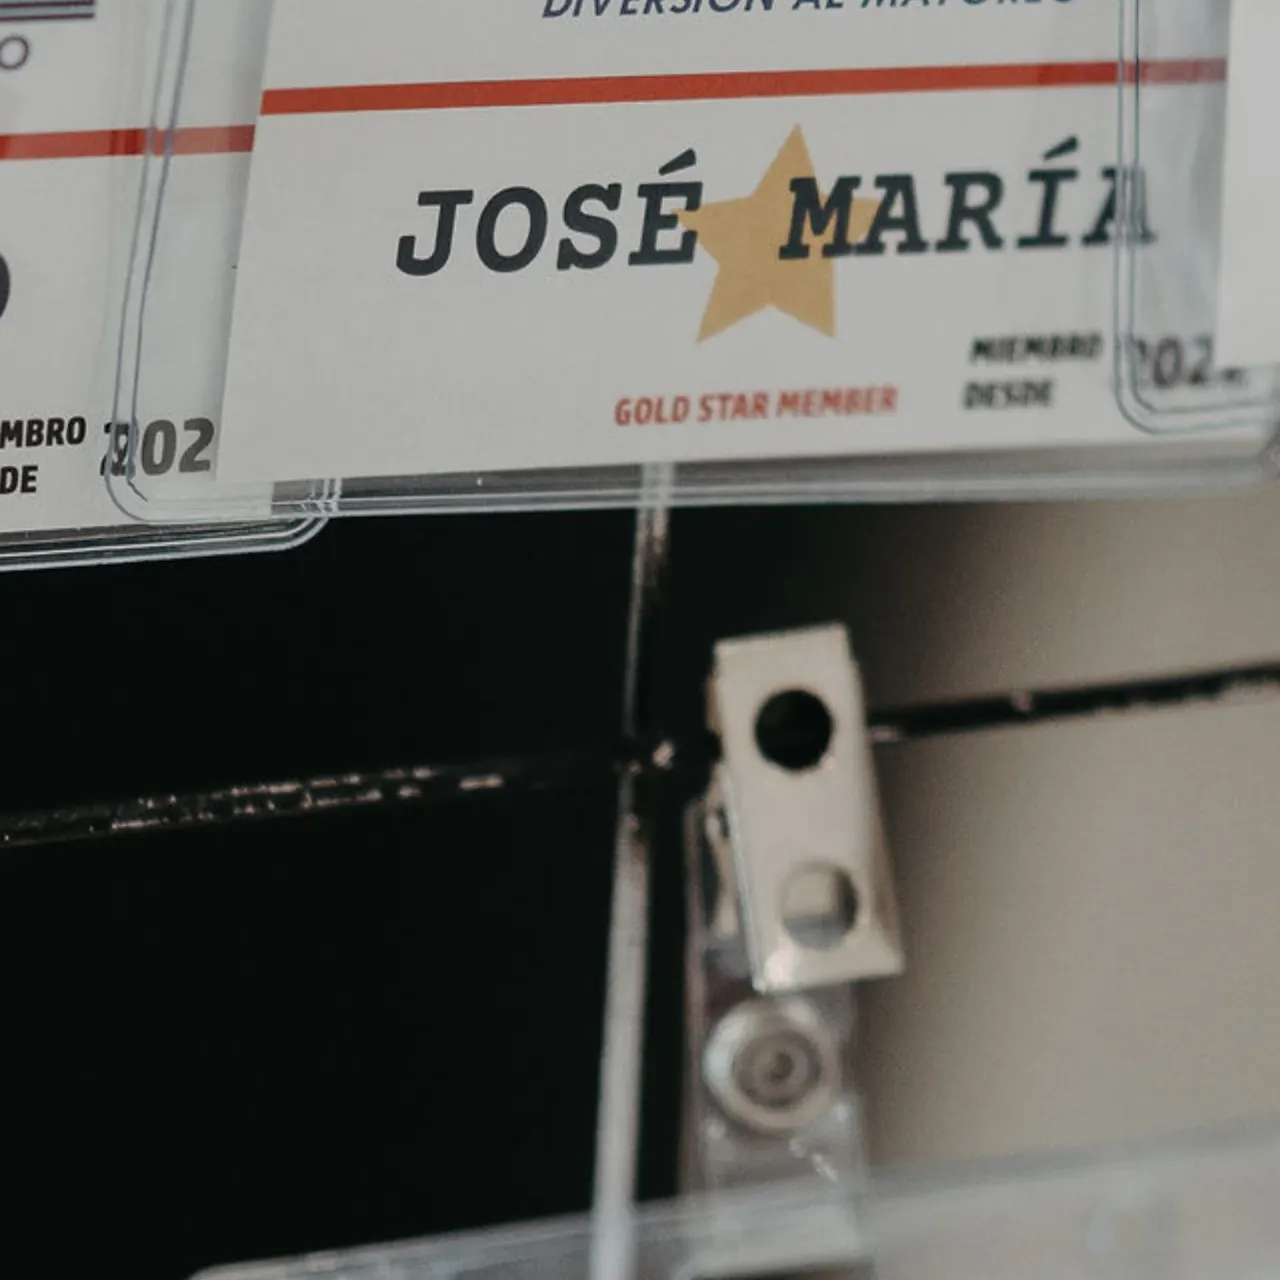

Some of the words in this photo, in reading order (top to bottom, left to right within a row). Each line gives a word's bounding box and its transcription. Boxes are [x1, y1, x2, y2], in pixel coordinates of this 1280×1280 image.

[395, 148, 704, 277] JOSÉ
[778, 136, 1157, 261] MARÍA
[613, 395, 691, 426] GOLD
[697, 392, 771, 422] STAR
[775, 386, 899, 418] MEMBER
